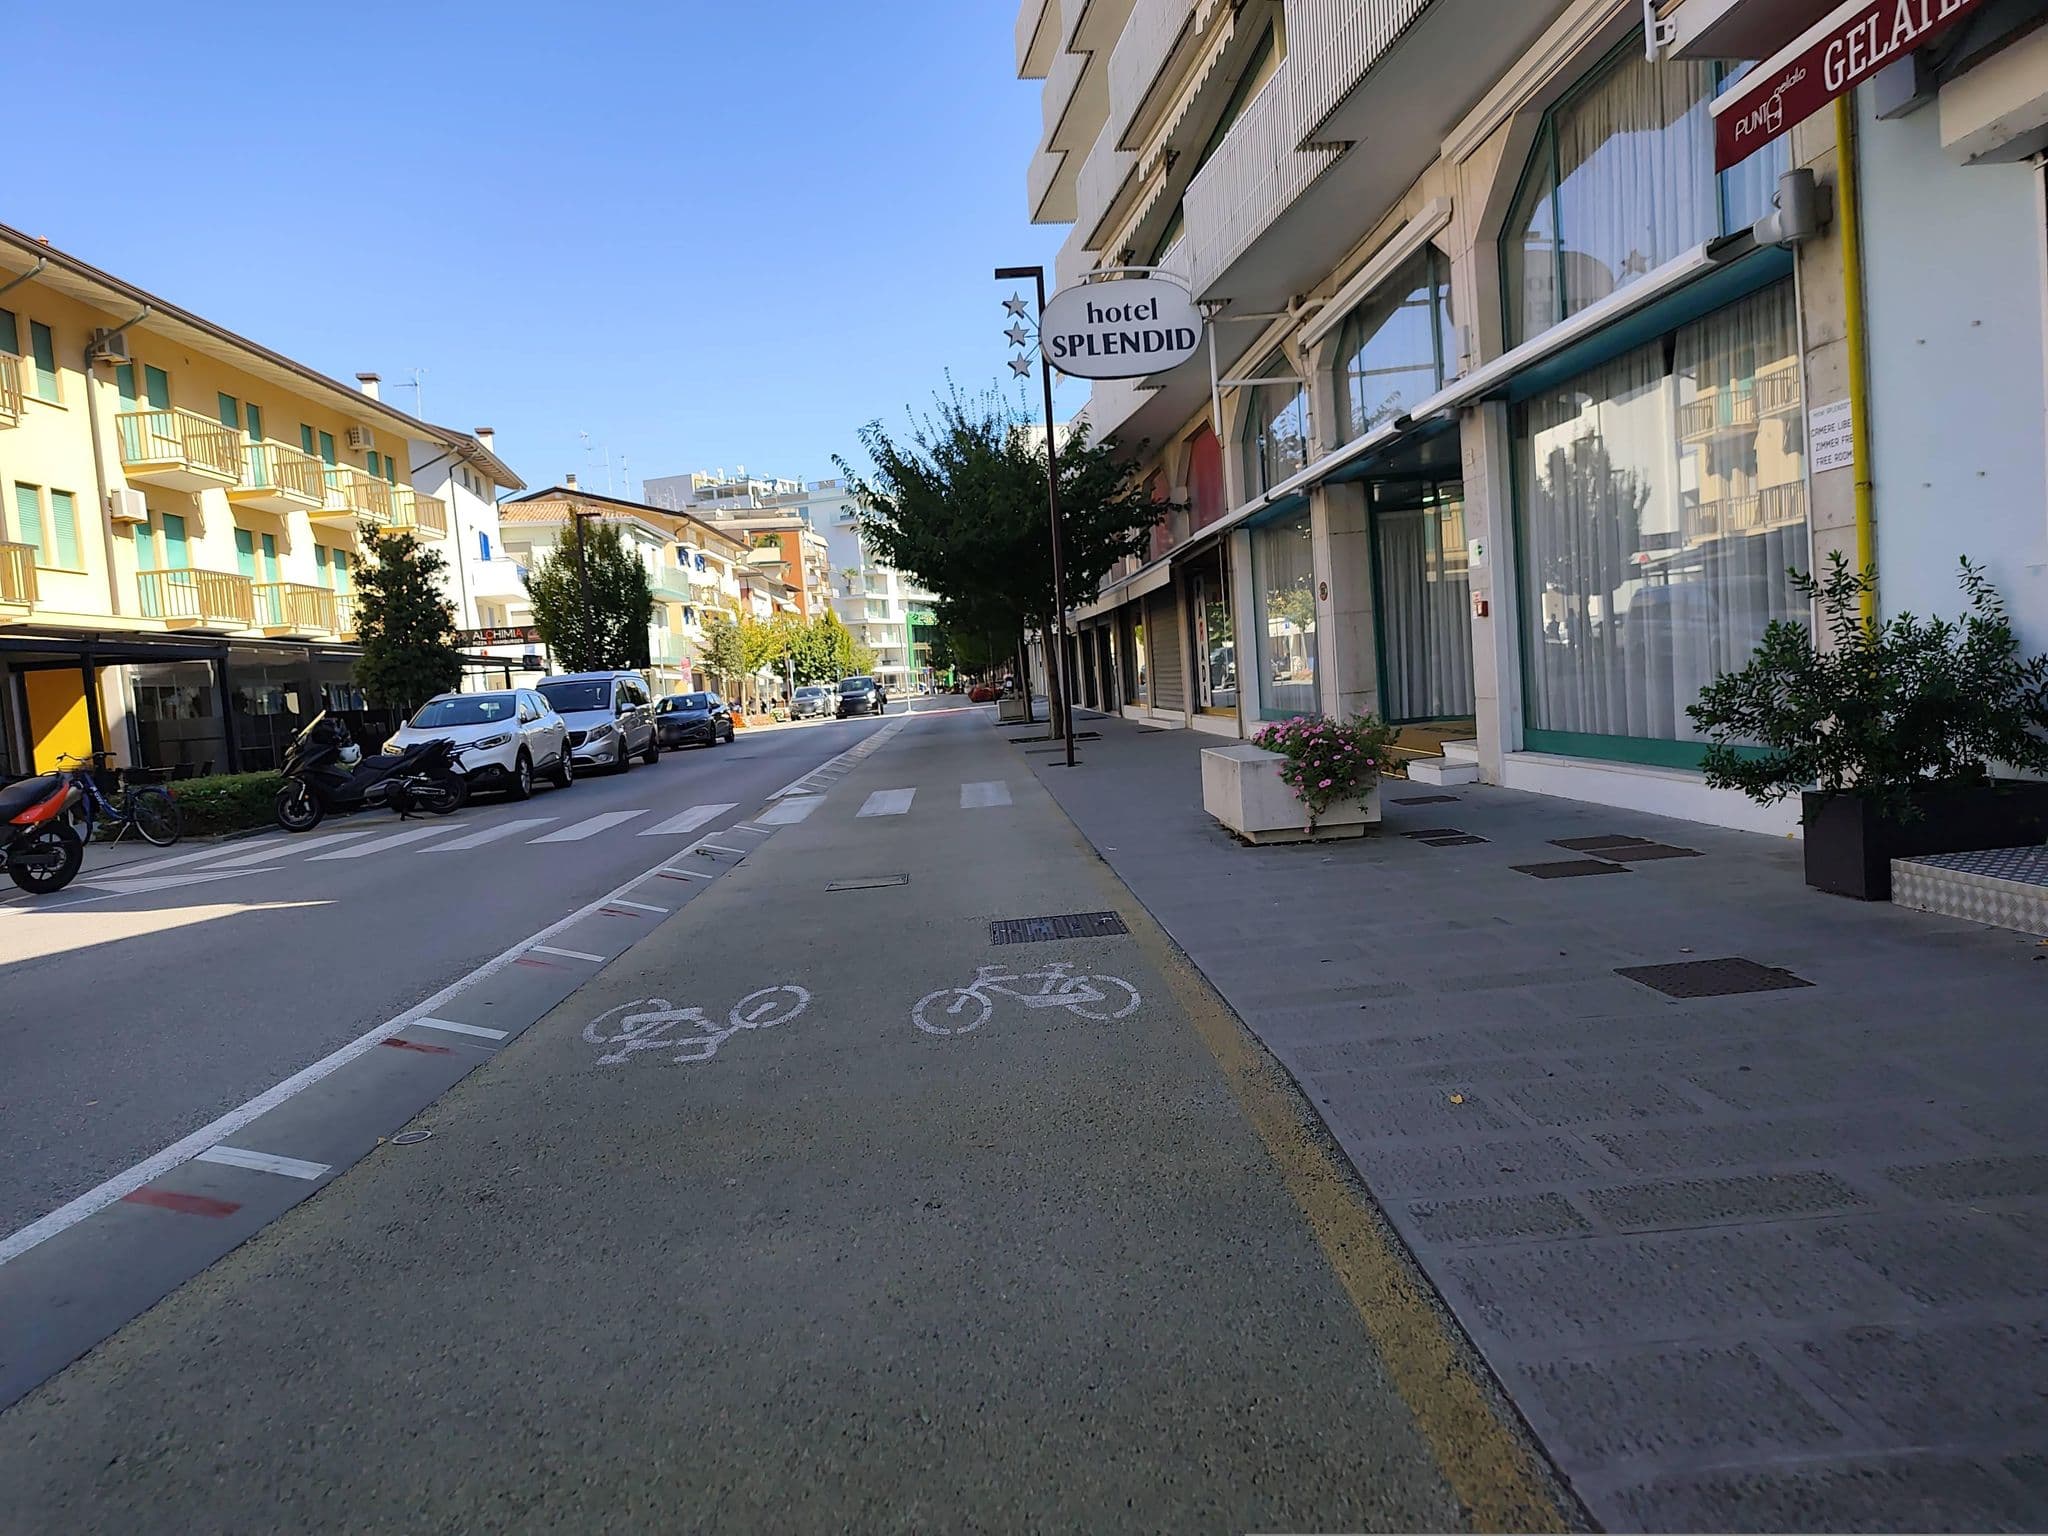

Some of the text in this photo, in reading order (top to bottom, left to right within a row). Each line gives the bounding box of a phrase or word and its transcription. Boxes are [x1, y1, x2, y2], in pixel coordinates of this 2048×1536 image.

[1823, 0, 1970, 92] GELAT
[1086, 297, 1158, 325] hotel
[1052, 327, 1196, 358] SPLENDID
[1838, 418, 1853, 431] LIBE
[1841, 433, 1854, 445] FRE
[1816, 454, 1832, 466] FREE
[473, 628, 525, 641] ALCHIMIA
